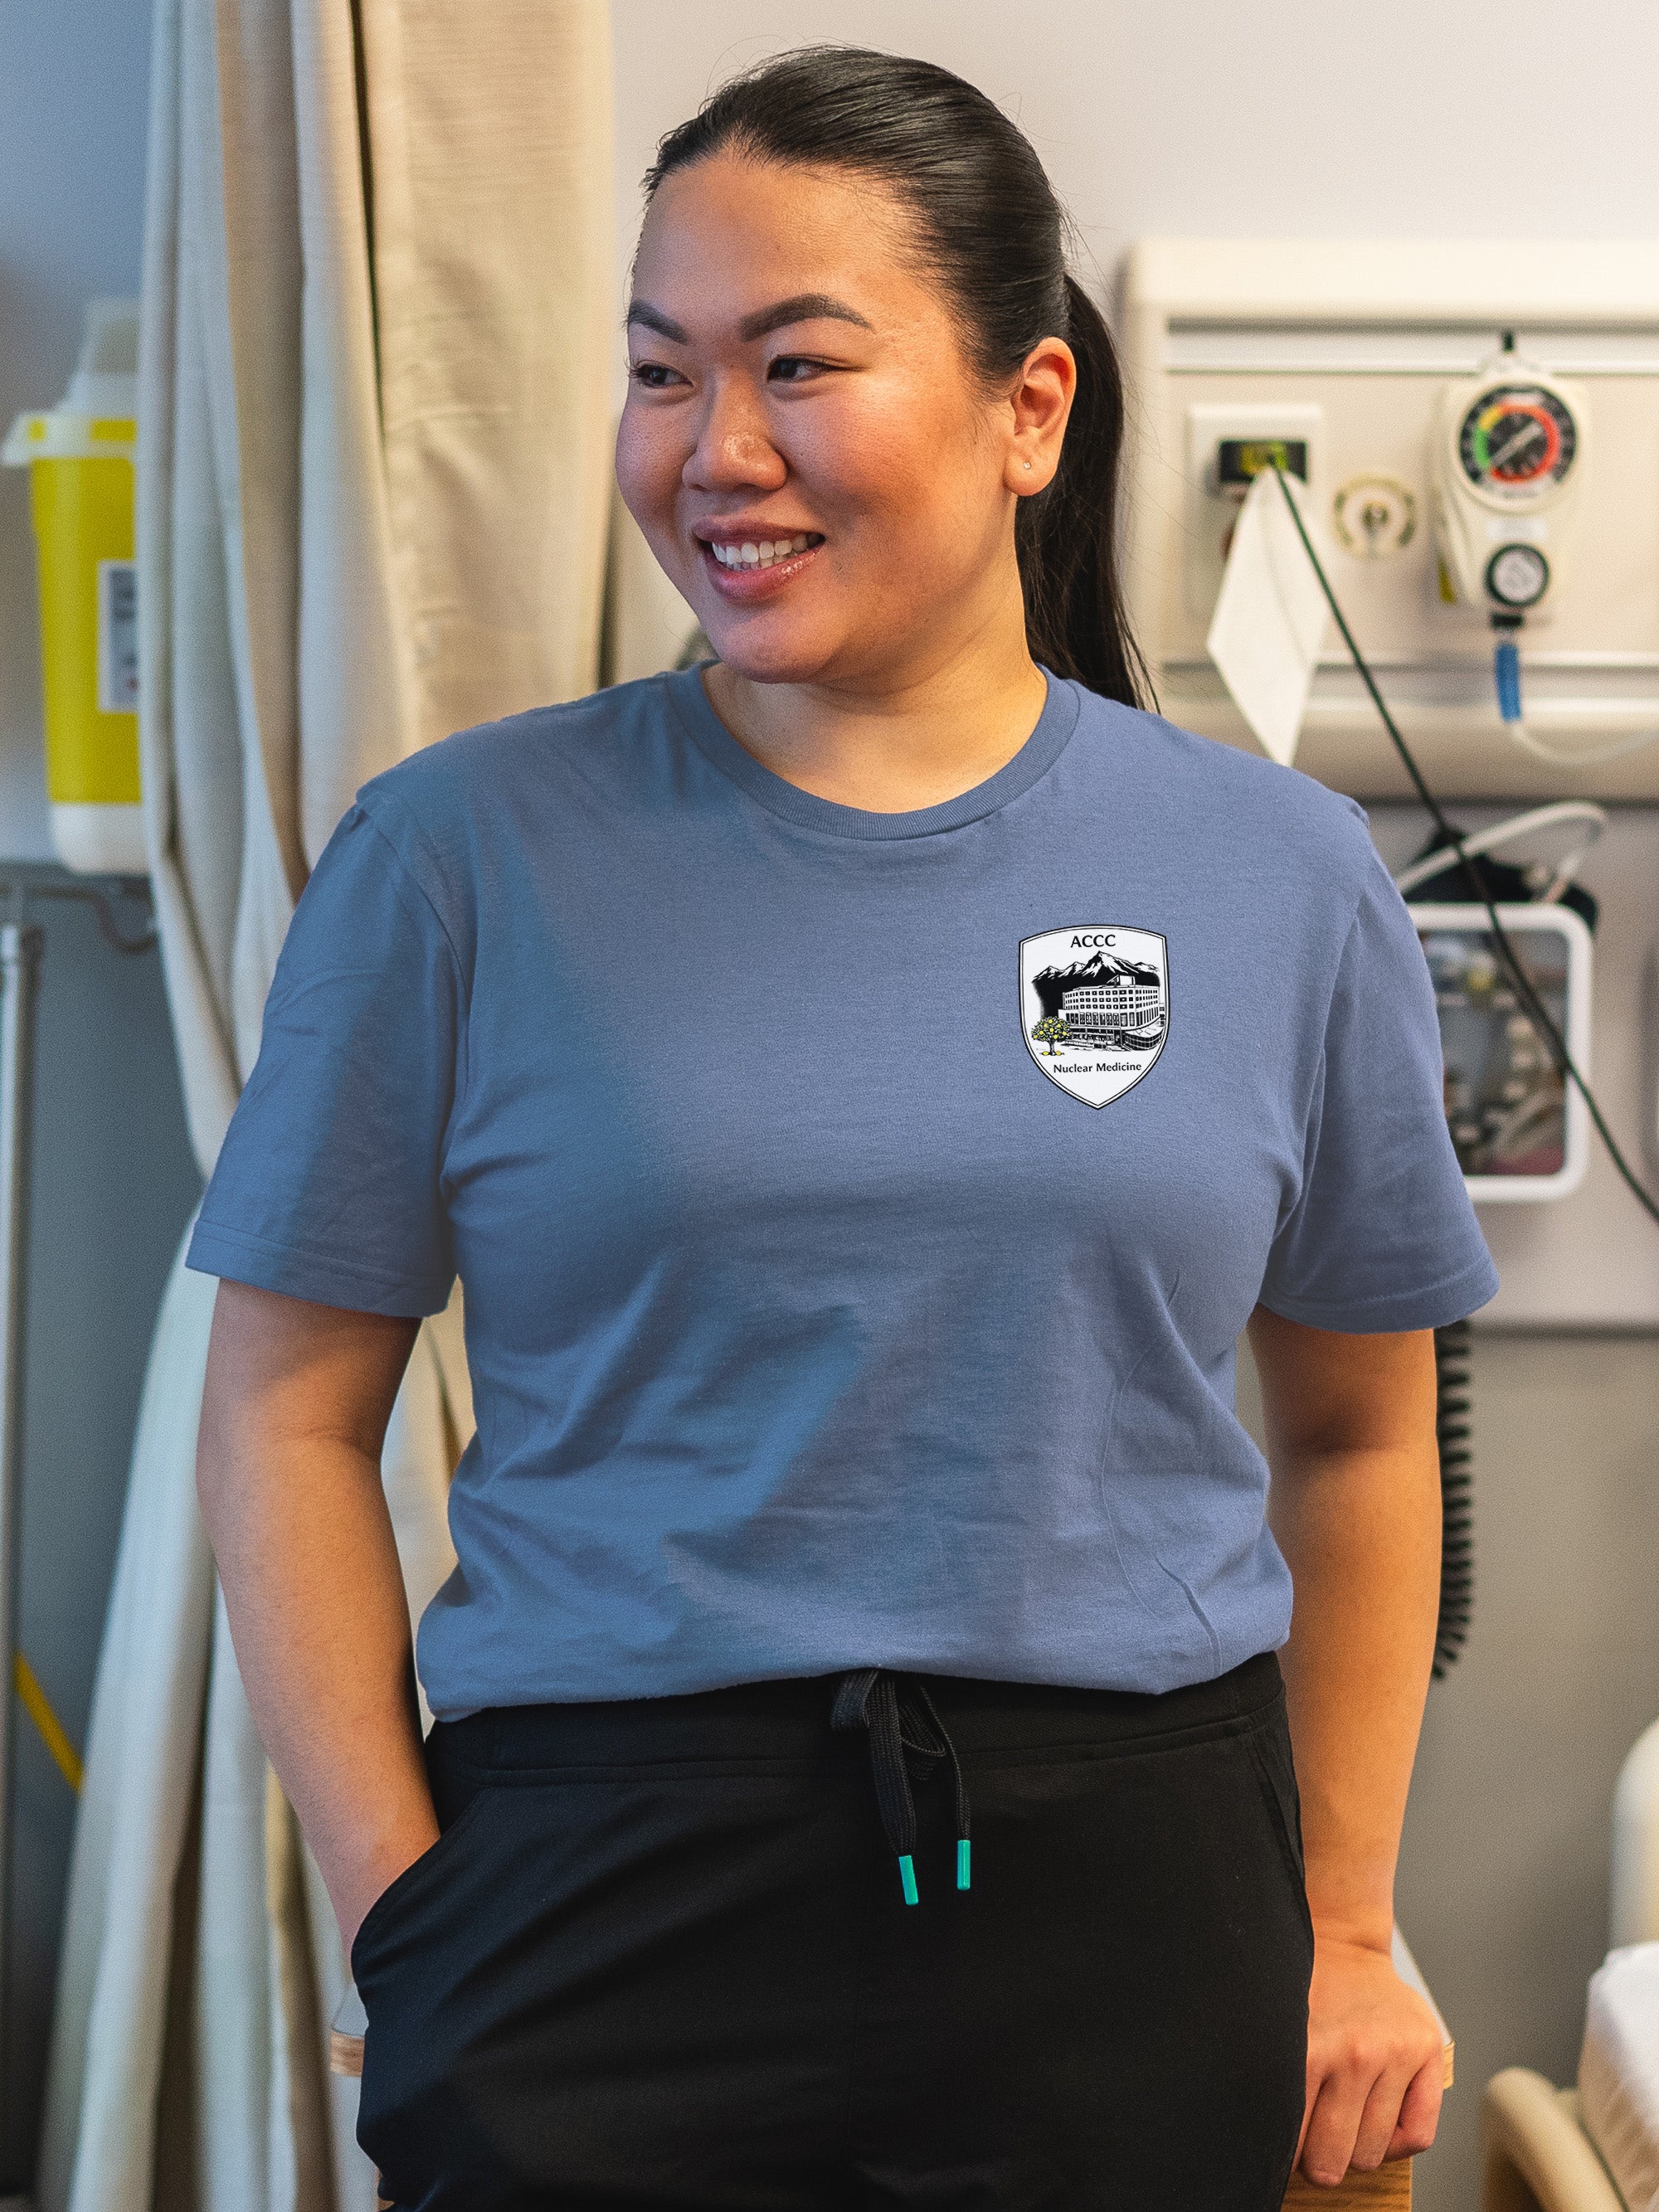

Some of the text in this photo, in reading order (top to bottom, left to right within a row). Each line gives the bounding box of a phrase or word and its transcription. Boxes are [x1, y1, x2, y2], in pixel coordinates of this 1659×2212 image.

[1070, 934, 1117, 948] ACCC
[1053, 1062, 1142, 1073] Nuclear Medicine
